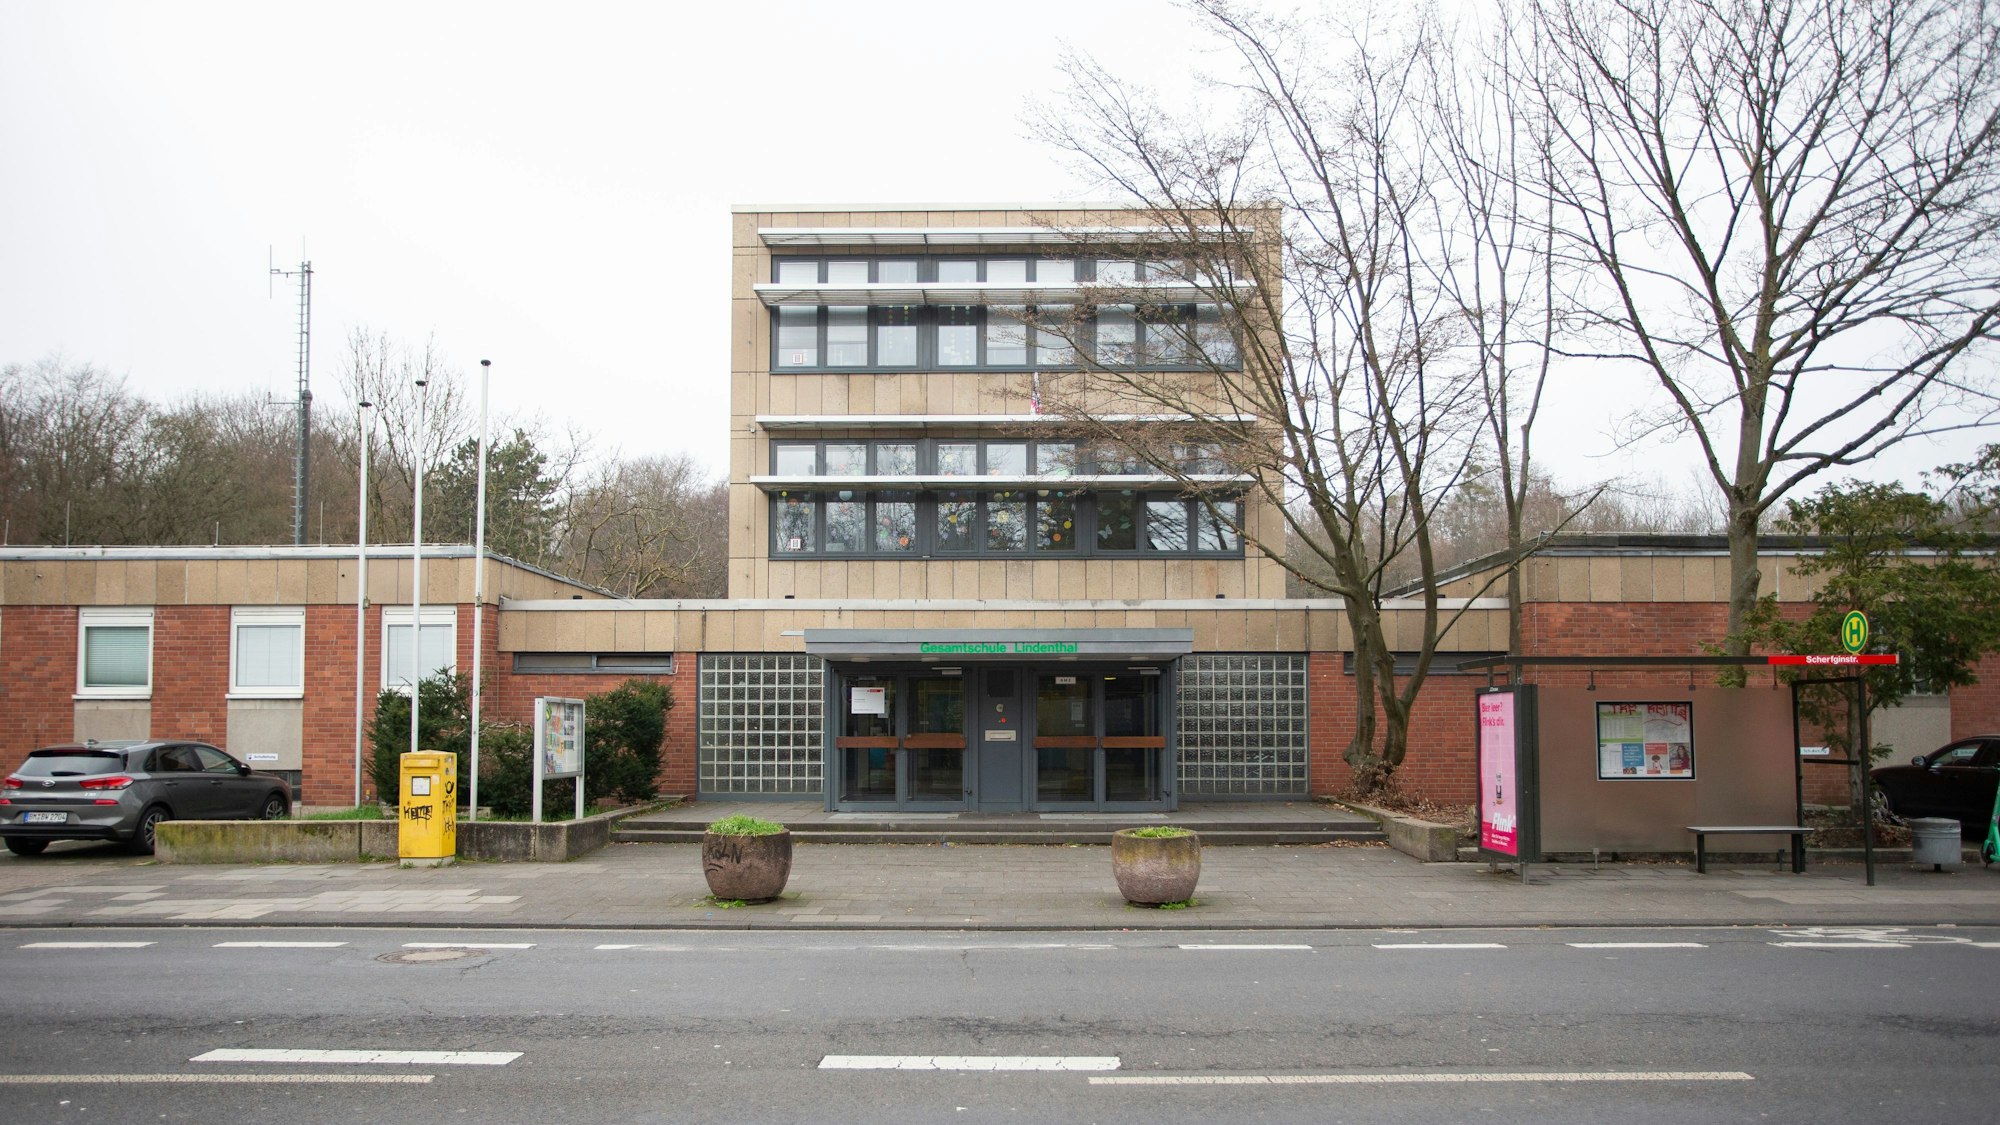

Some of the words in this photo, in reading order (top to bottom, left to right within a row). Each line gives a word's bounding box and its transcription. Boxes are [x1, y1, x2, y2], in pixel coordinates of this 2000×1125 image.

[1849, 621, 1860, 643] H
[920, 642, 1007, 653] Gesamtschule
[1015, 641, 1078, 653] Lindenthal
[1806, 655, 1858, 664] Scherfginstr.
[1492, 812, 1512, 833] Flink
